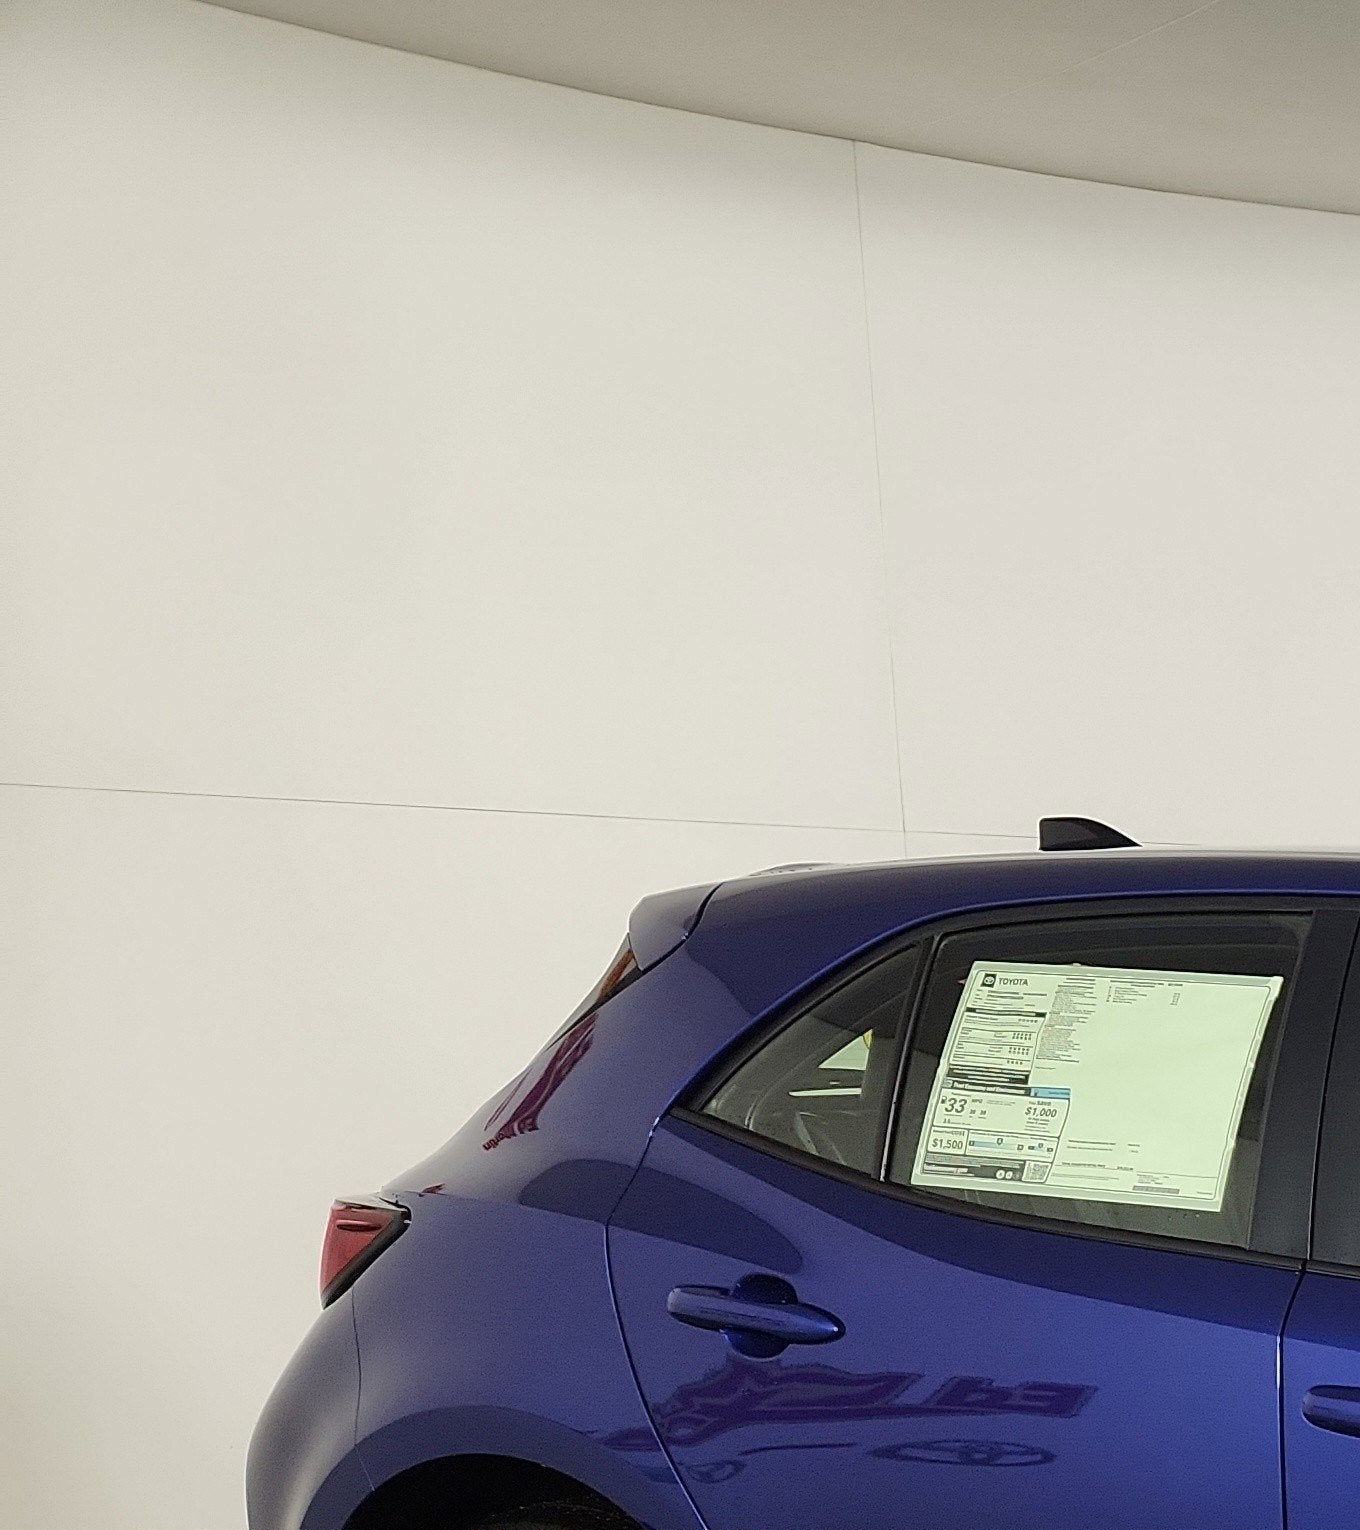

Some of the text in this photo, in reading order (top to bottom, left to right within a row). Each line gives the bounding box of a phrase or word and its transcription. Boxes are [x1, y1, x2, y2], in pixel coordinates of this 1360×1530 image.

[998, 977, 1029, 987] TOYOTA
[944, 1097, 968, 1114] 33
[1024, 1106, 1058, 1118] $1,000
[932, 1137, 964, 1149] $1,500
